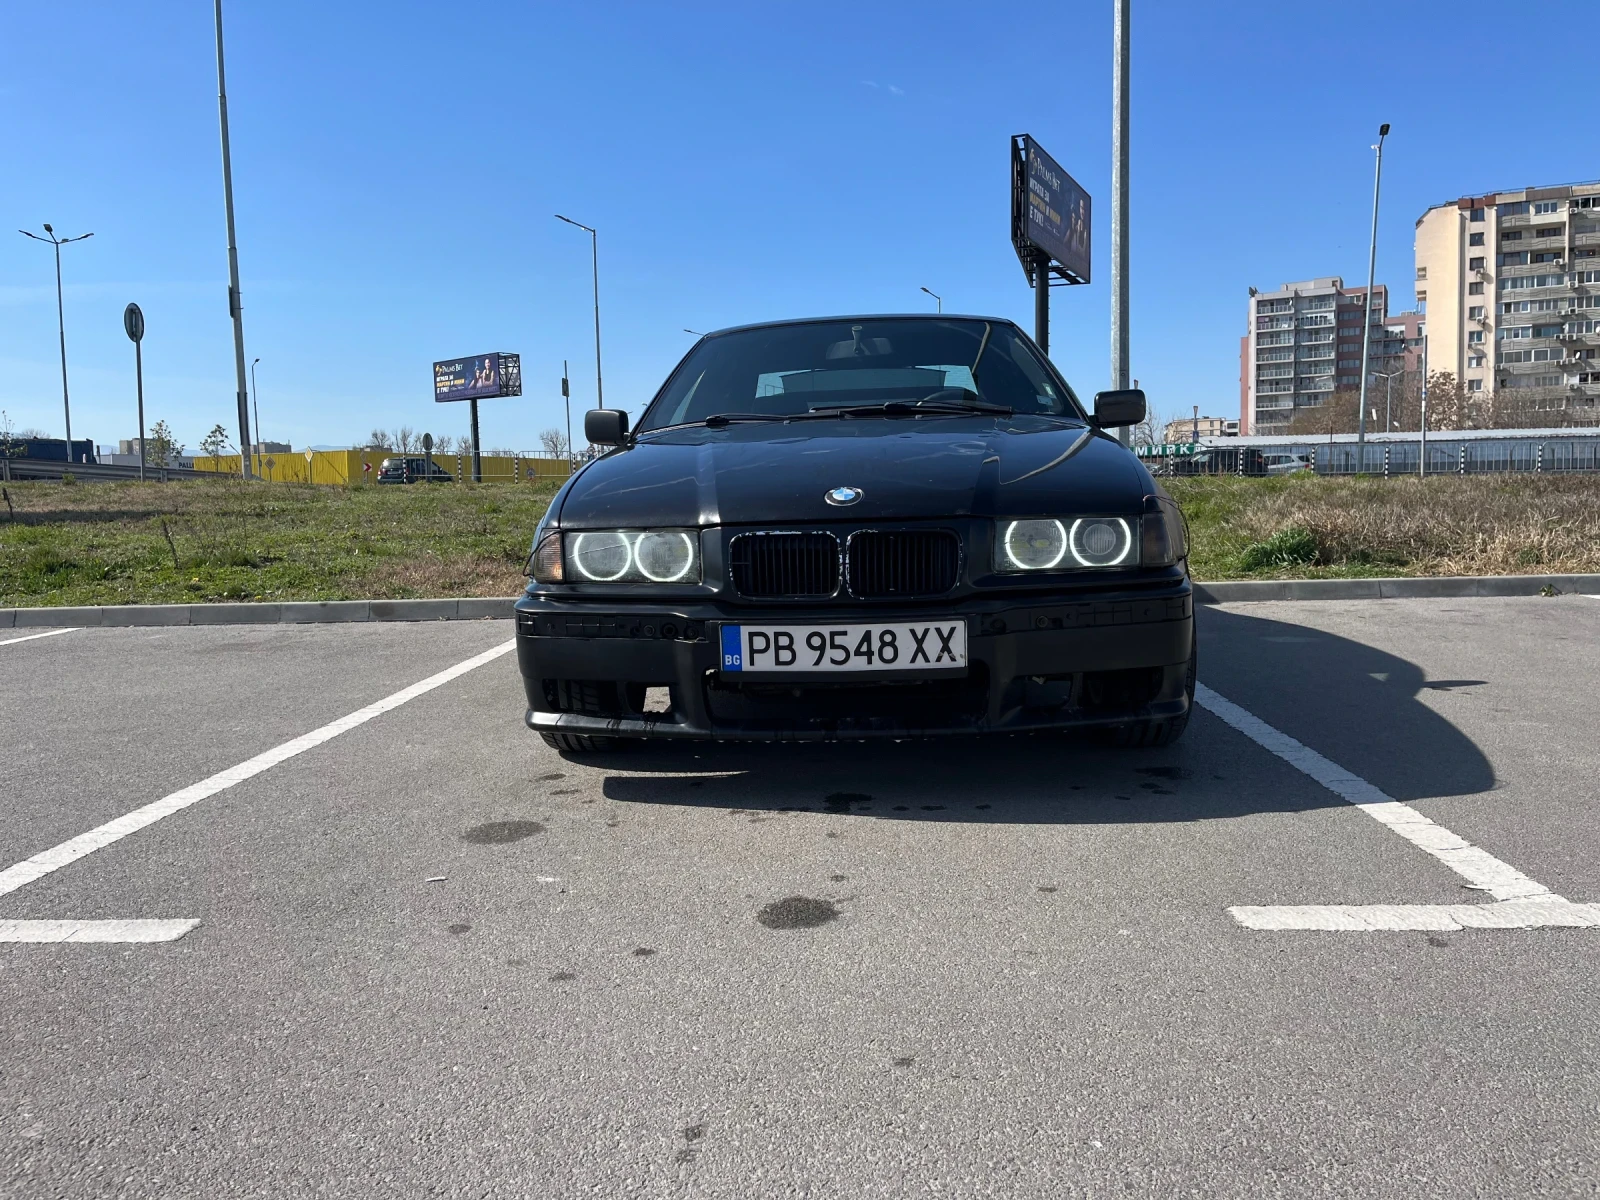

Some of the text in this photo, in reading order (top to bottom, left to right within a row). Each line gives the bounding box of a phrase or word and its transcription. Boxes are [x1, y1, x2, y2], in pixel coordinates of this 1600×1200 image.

[747, 626, 957, 666] PB 9548 XX
[725, 654, 741, 665] BG
